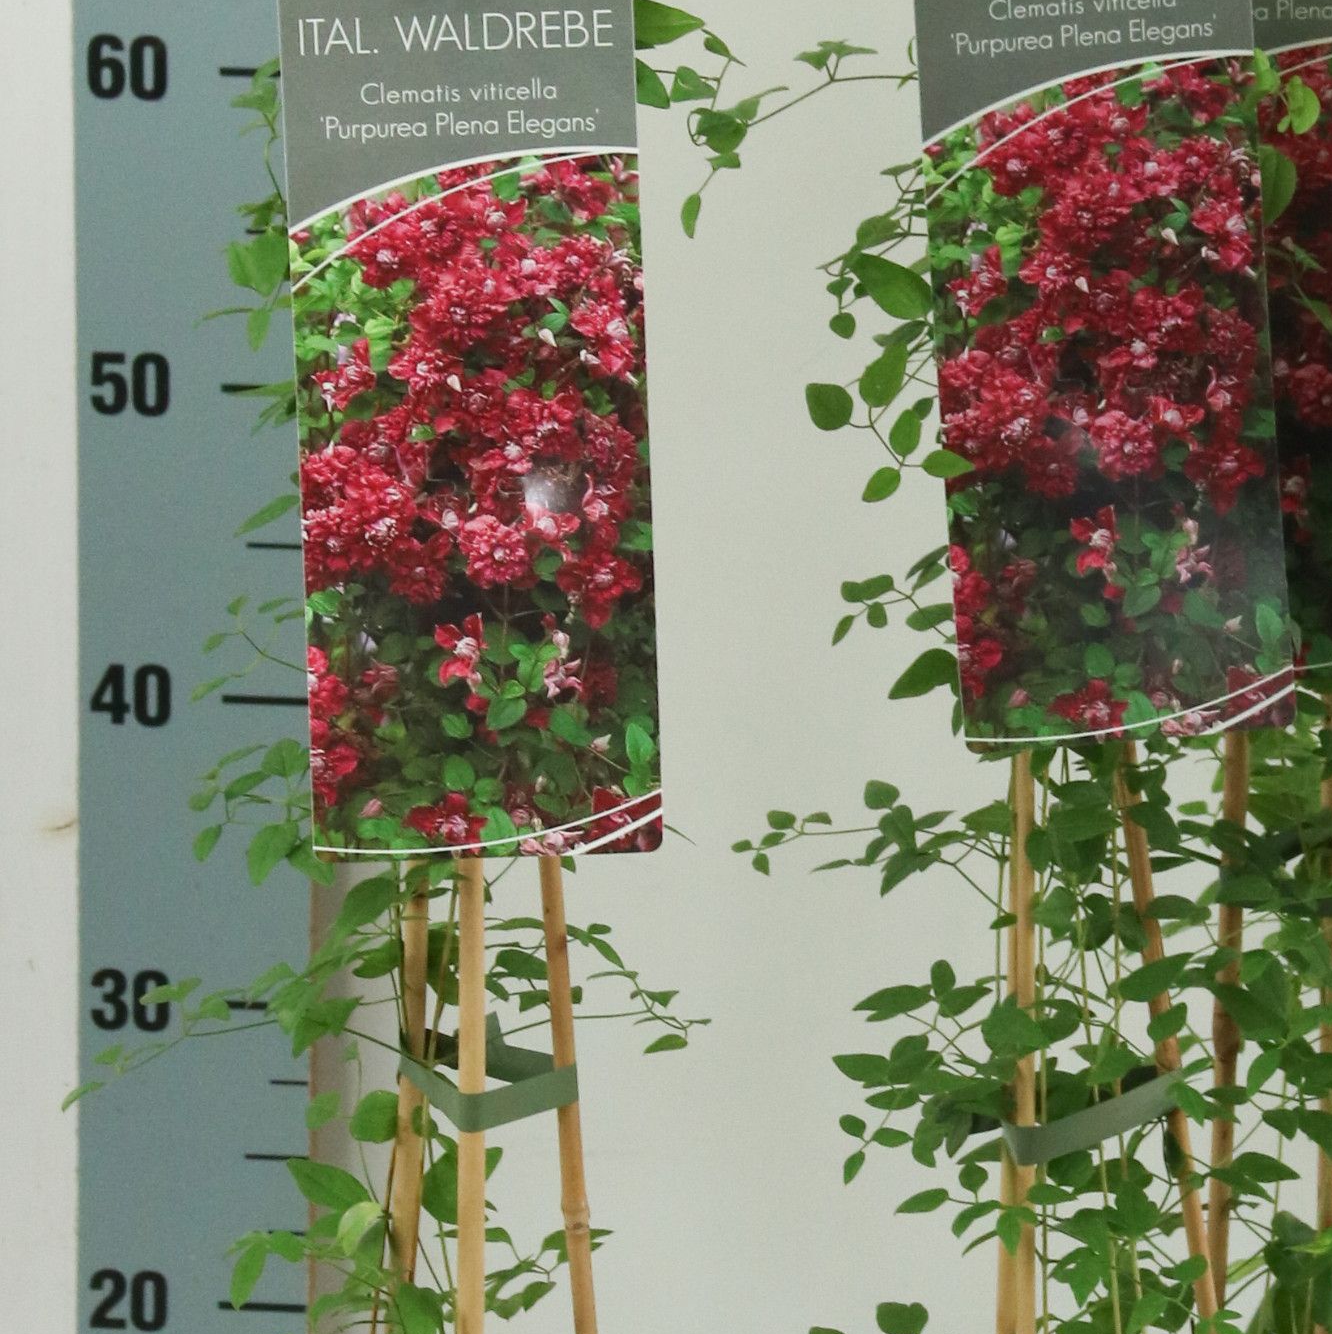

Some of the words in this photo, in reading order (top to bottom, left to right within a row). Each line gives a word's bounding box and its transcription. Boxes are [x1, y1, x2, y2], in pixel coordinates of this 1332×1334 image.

[298, 16, 379, 56] ITAL.
[394, 9, 614, 52] WALDREBE
[951, 29, 1055, 59] 'Purpurea
[1060, 24, 1121, 48] Plena
[1129, 13, 1216, 44] Elegans'
[85, 33, 168, 102] 60
[360, 82, 461, 105] Clematis
[469, 78, 558, 102] viticella
[320, 116, 427, 143] 'Purpurea
[435, 112, 499, 136] Plena
[508, 108, 600, 138] Elegans'
[89, 350, 171, 418] 50
[88, 663, 173, 729] 40
[89, 967, 171, 1033] 30
[87, 1267, 169, 1333] 20
